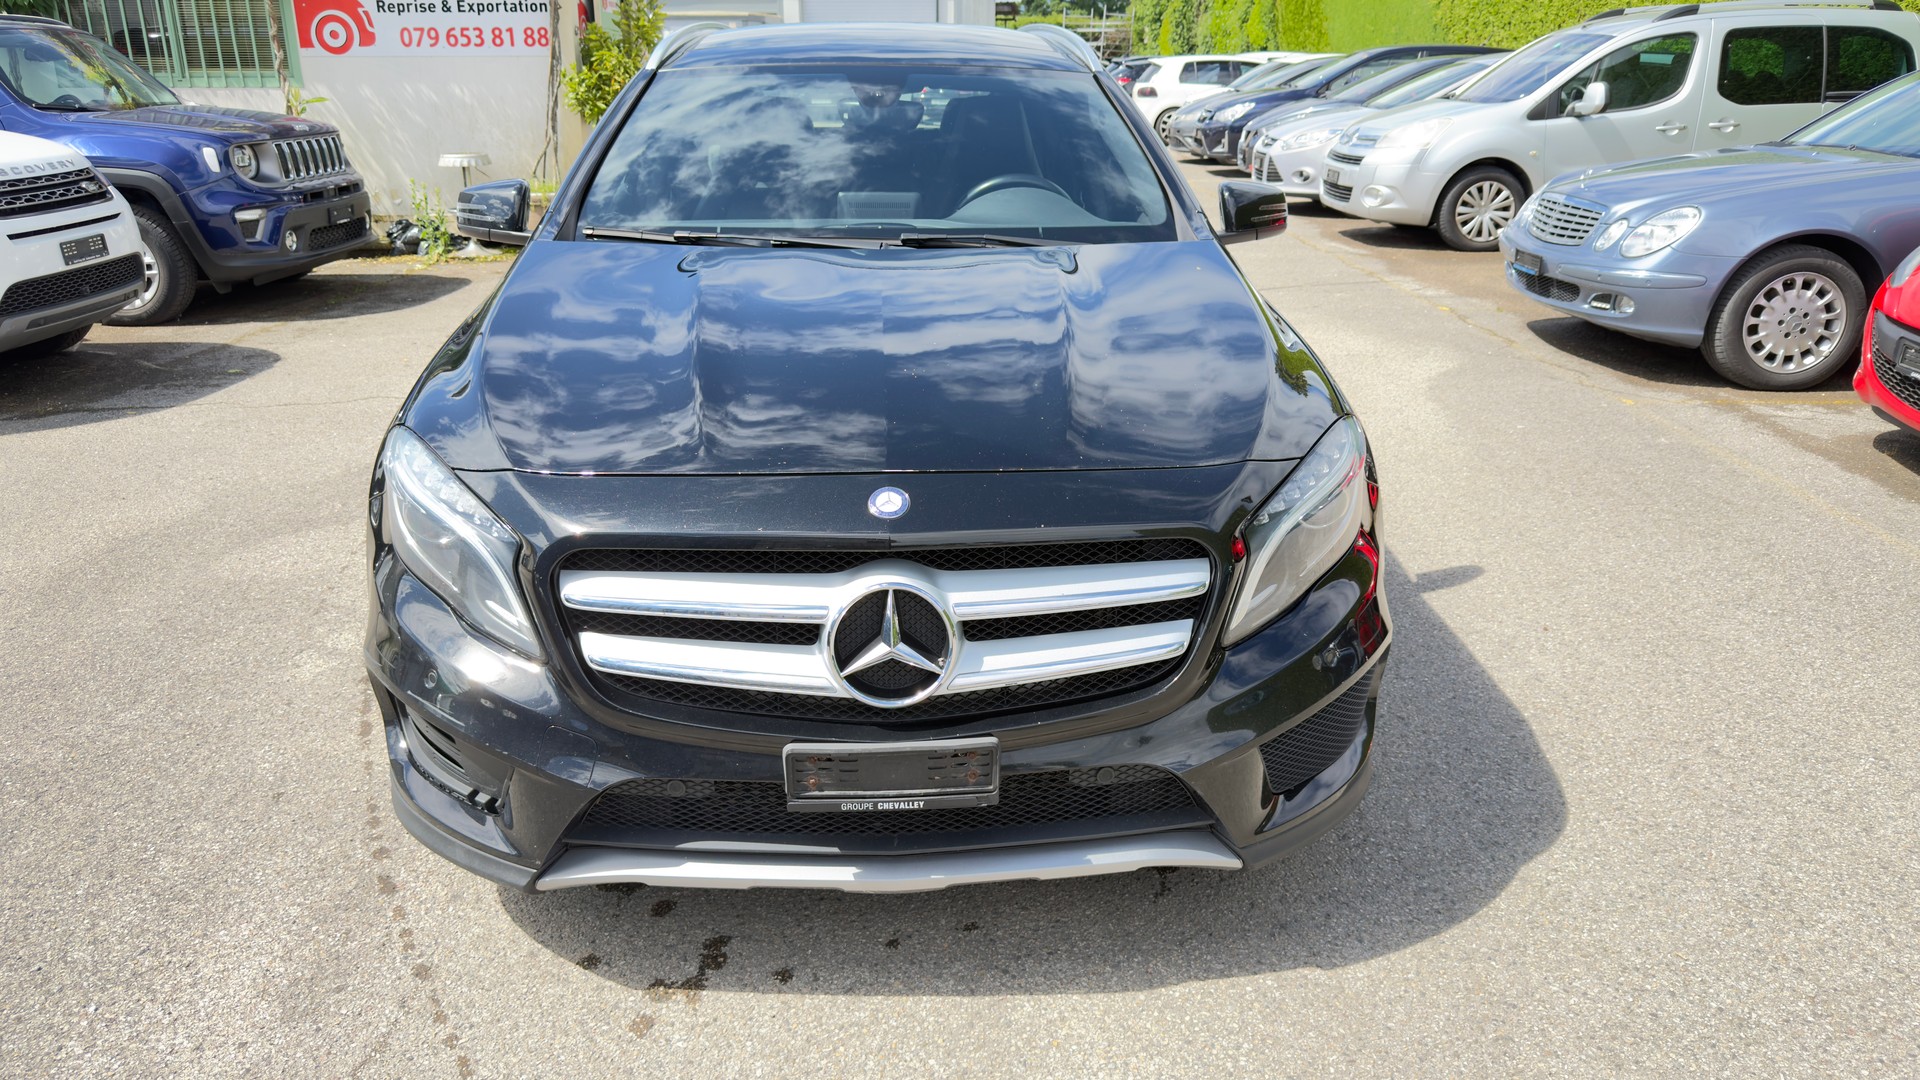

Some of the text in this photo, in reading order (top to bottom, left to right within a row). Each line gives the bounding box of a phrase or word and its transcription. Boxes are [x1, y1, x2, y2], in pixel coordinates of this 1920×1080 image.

[376, 0, 548, 15] Reprise & Exportation
[400, 27, 549, 47] 079 653 81 88
[841, 801, 925, 811] GROUPE CHEVALLEY
